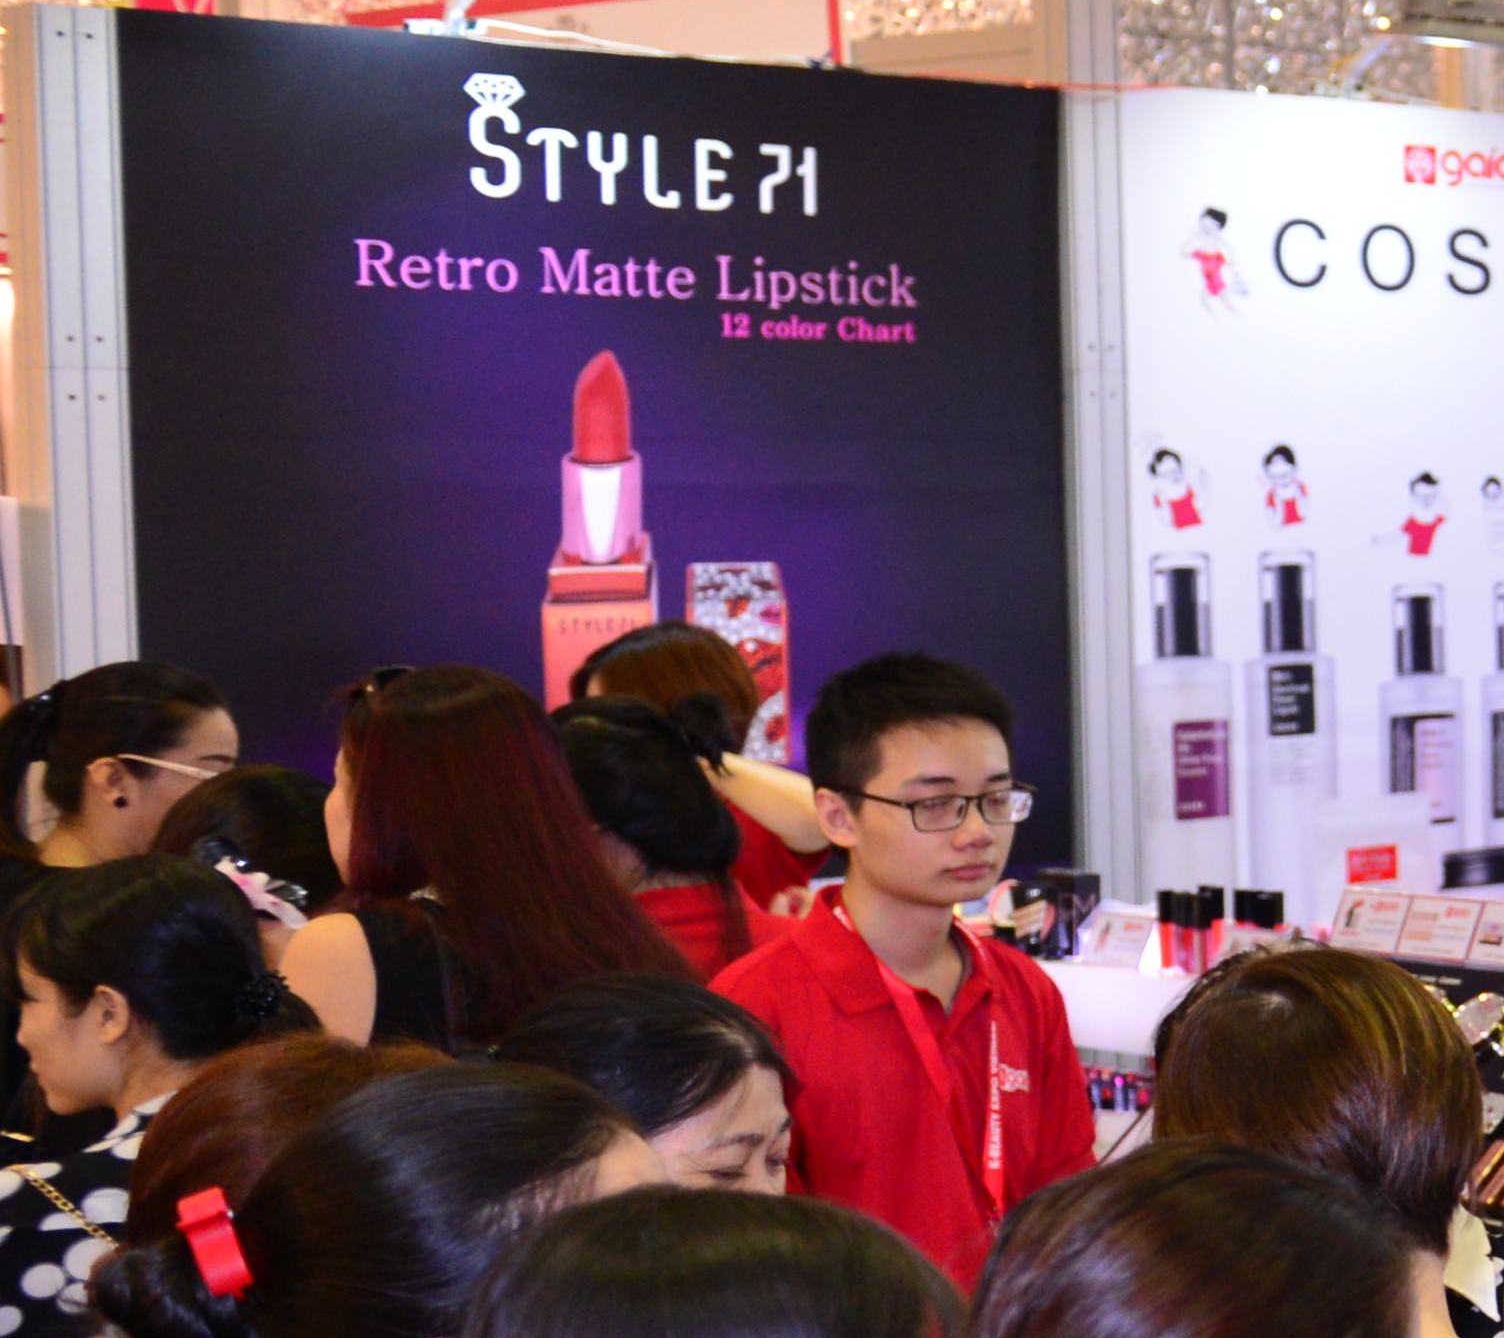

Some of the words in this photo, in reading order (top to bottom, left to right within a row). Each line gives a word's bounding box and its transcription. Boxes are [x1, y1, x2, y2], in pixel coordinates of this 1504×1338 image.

[468, 103, 735, 212] STYLE
[354, 238, 518, 294] Retro
[540, 247, 696, 301] Matte
[716, 256, 918, 311] Lipstick
[720, 314, 751, 339] 12
[761, 316, 828, 341] color
[838, 316, 916, 344] Chart
